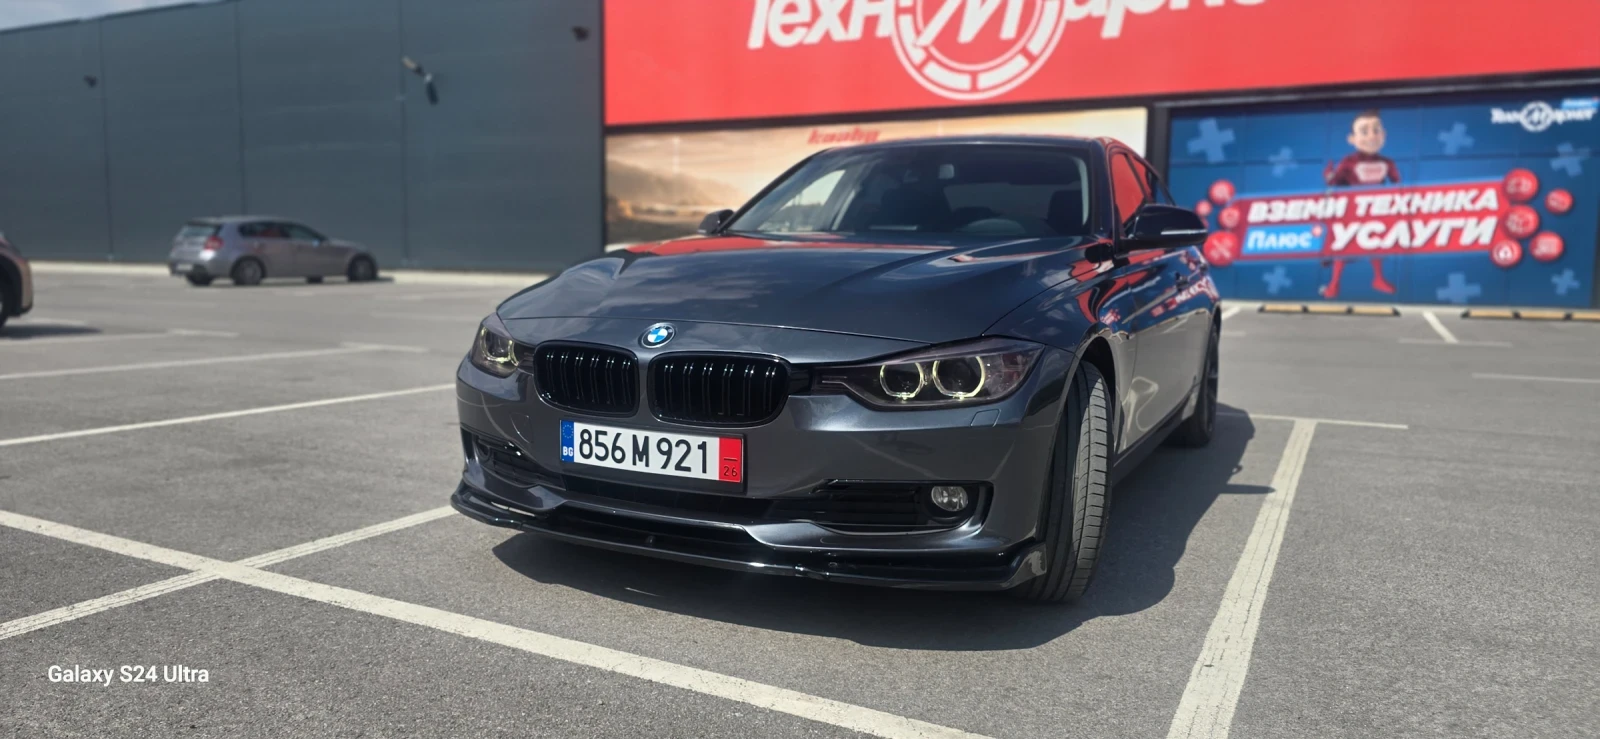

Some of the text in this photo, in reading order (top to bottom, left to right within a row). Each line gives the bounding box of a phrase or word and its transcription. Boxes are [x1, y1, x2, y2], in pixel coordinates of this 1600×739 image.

[1248, 187, 1498, 223] ВЗЕМИ ТЕХНИКА
[1331, 216, 1498, 251] УСЛУГИ
[562, 446, 574, 457] BG
[579, 428, 707, 474] 856 M 921
[723, 465, 738, 477] 26
